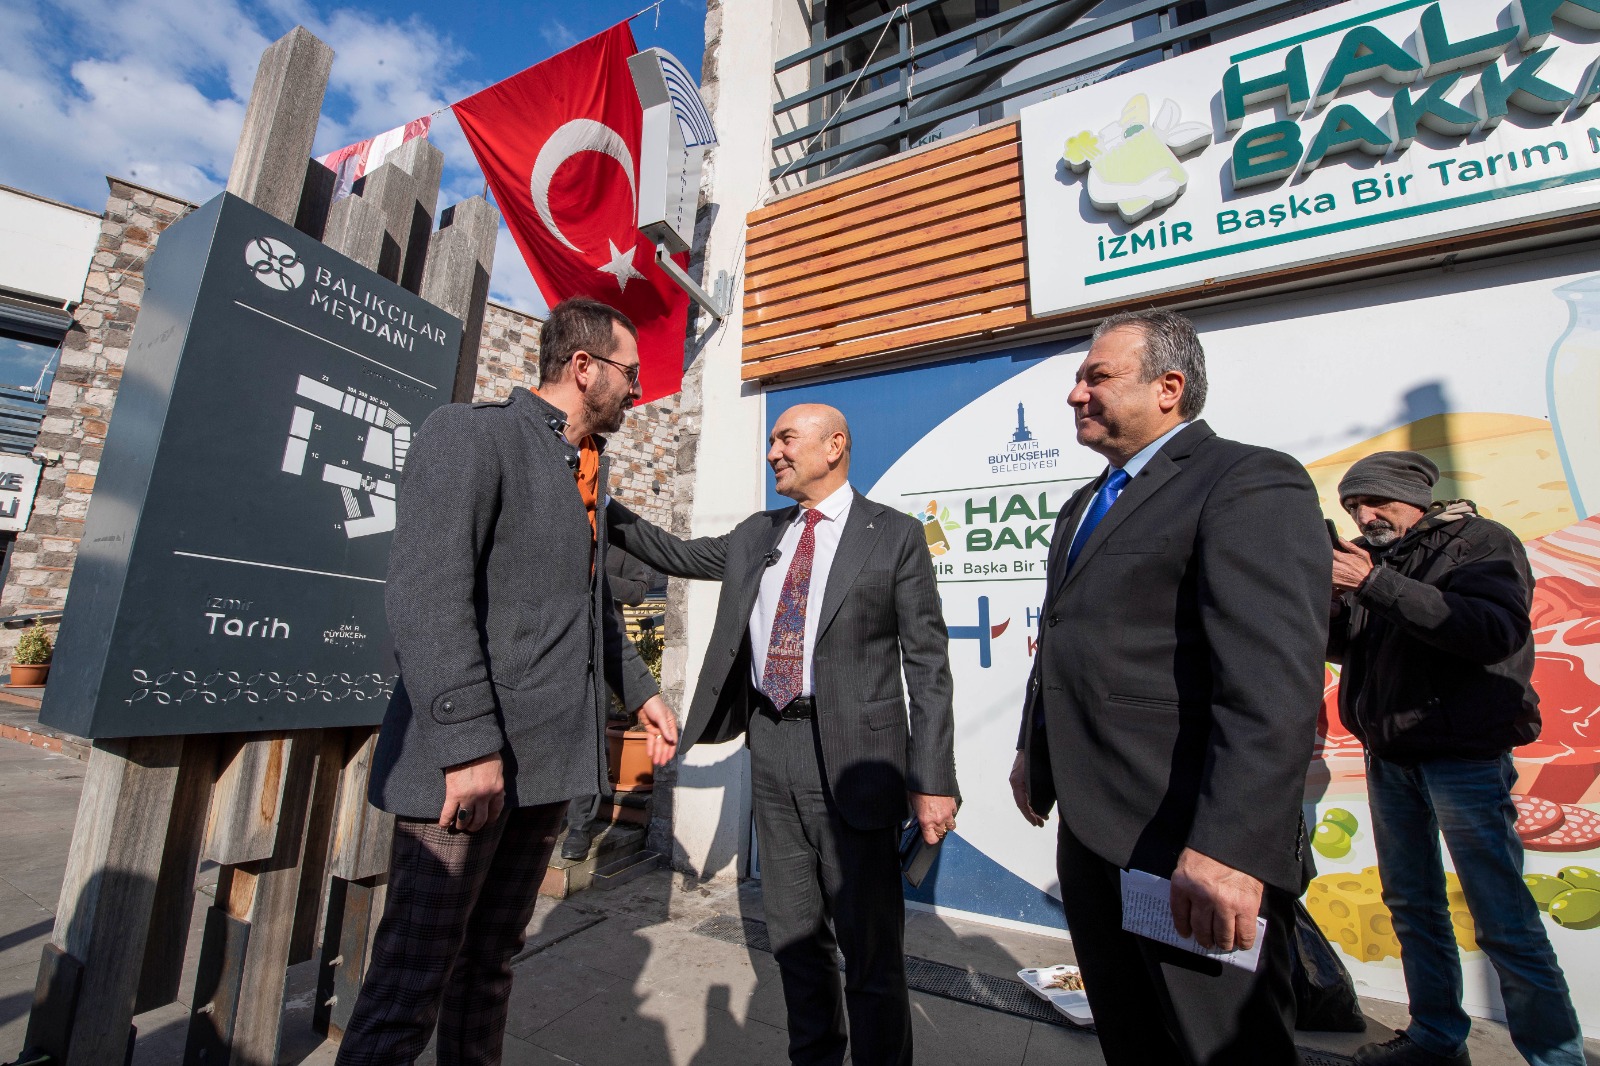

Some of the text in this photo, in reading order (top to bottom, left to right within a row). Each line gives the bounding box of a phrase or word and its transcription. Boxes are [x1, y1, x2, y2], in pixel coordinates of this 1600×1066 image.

[1231, 46, 1600, 184] BAKK
[1096, 141, 1568, 262] İZMİR Başka Bir Tarım
[310, 288, 415, 352] MEYDANI
[315, 265, 447, 346] BALIKÇILAR
[988, 448, 1060, 465] BÜYÜKŞEHİR
[991, 459, 1057, 474] BELEDİYESİ
[963, 561, 1008, 576] Başka
[1013, 560, 1035, 573] Bir
[205, 612, 290, 639] Tarih
